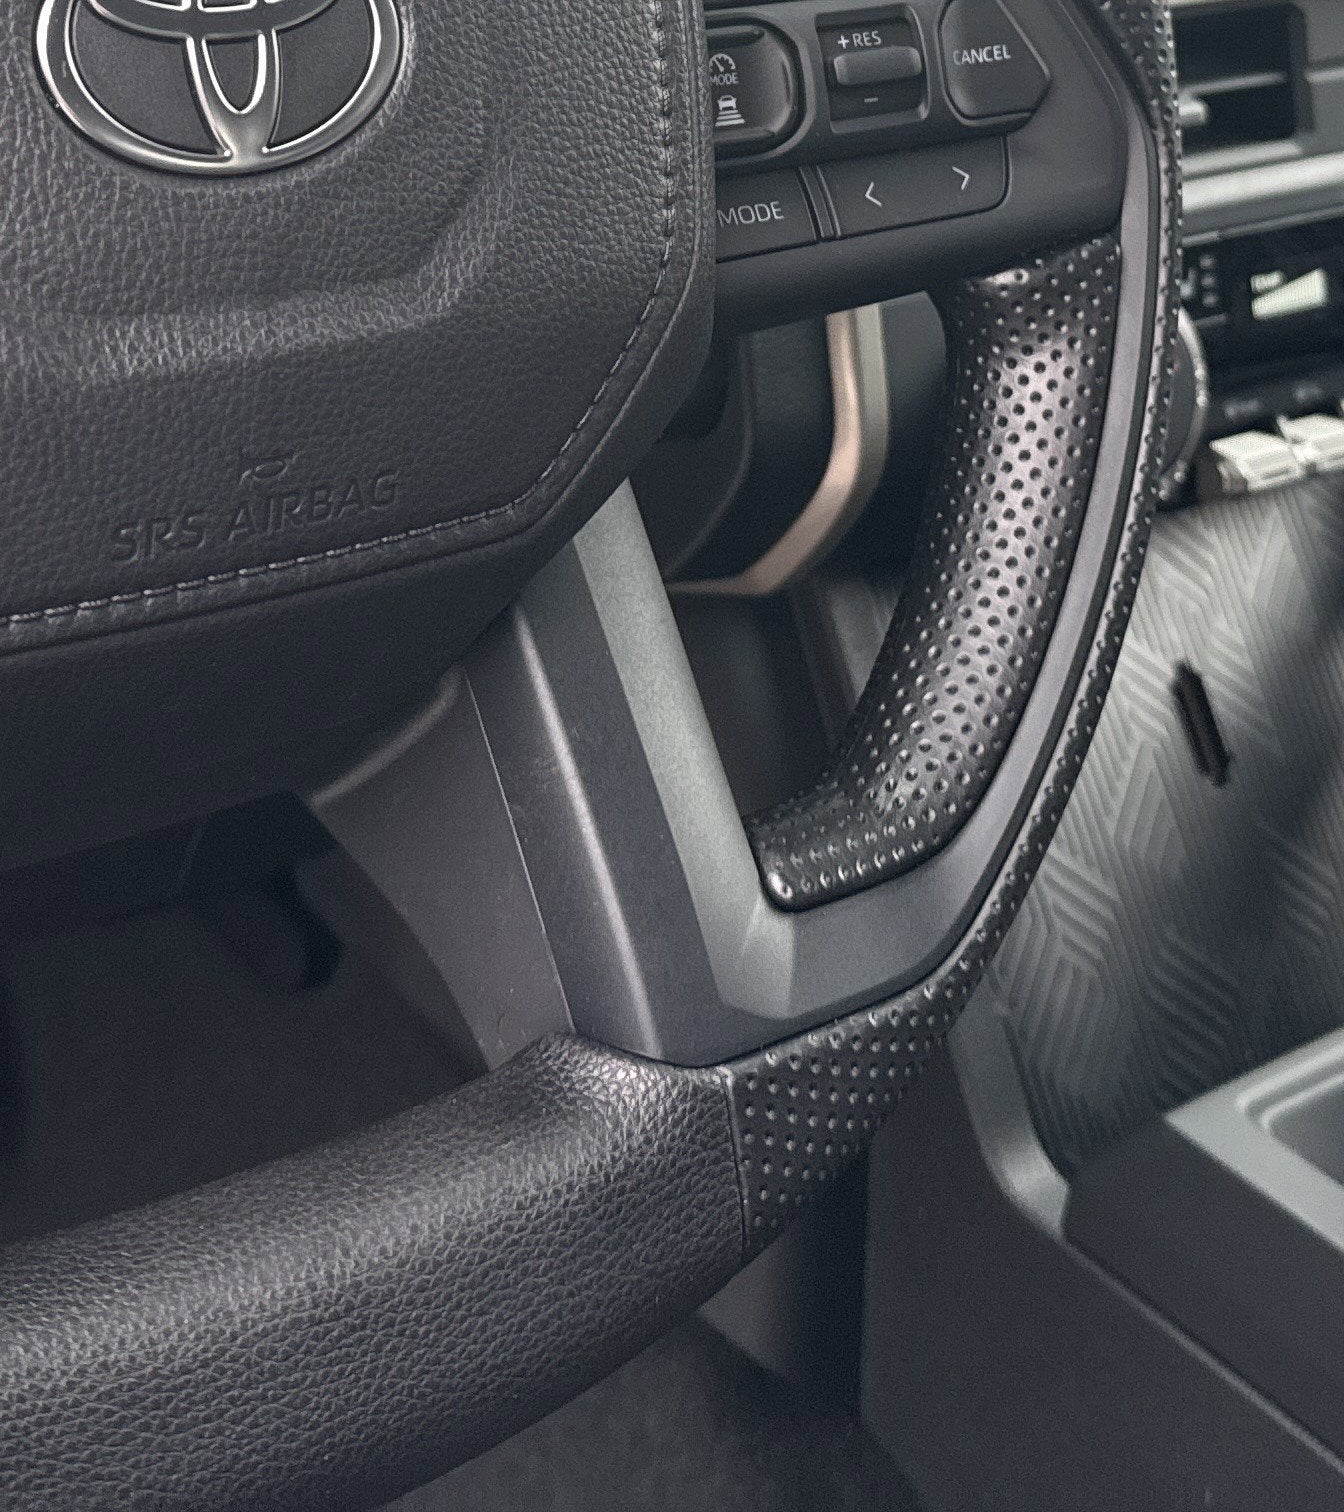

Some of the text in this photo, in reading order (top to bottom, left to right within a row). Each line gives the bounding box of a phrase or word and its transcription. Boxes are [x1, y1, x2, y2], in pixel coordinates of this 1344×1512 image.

[953, 43, 1011, 67] CANCEL
[709, 72, 739, 86] MODE
[716, 200, 785, 228] MODE
[111, 469, 402, 565] SRS AIRBAG
